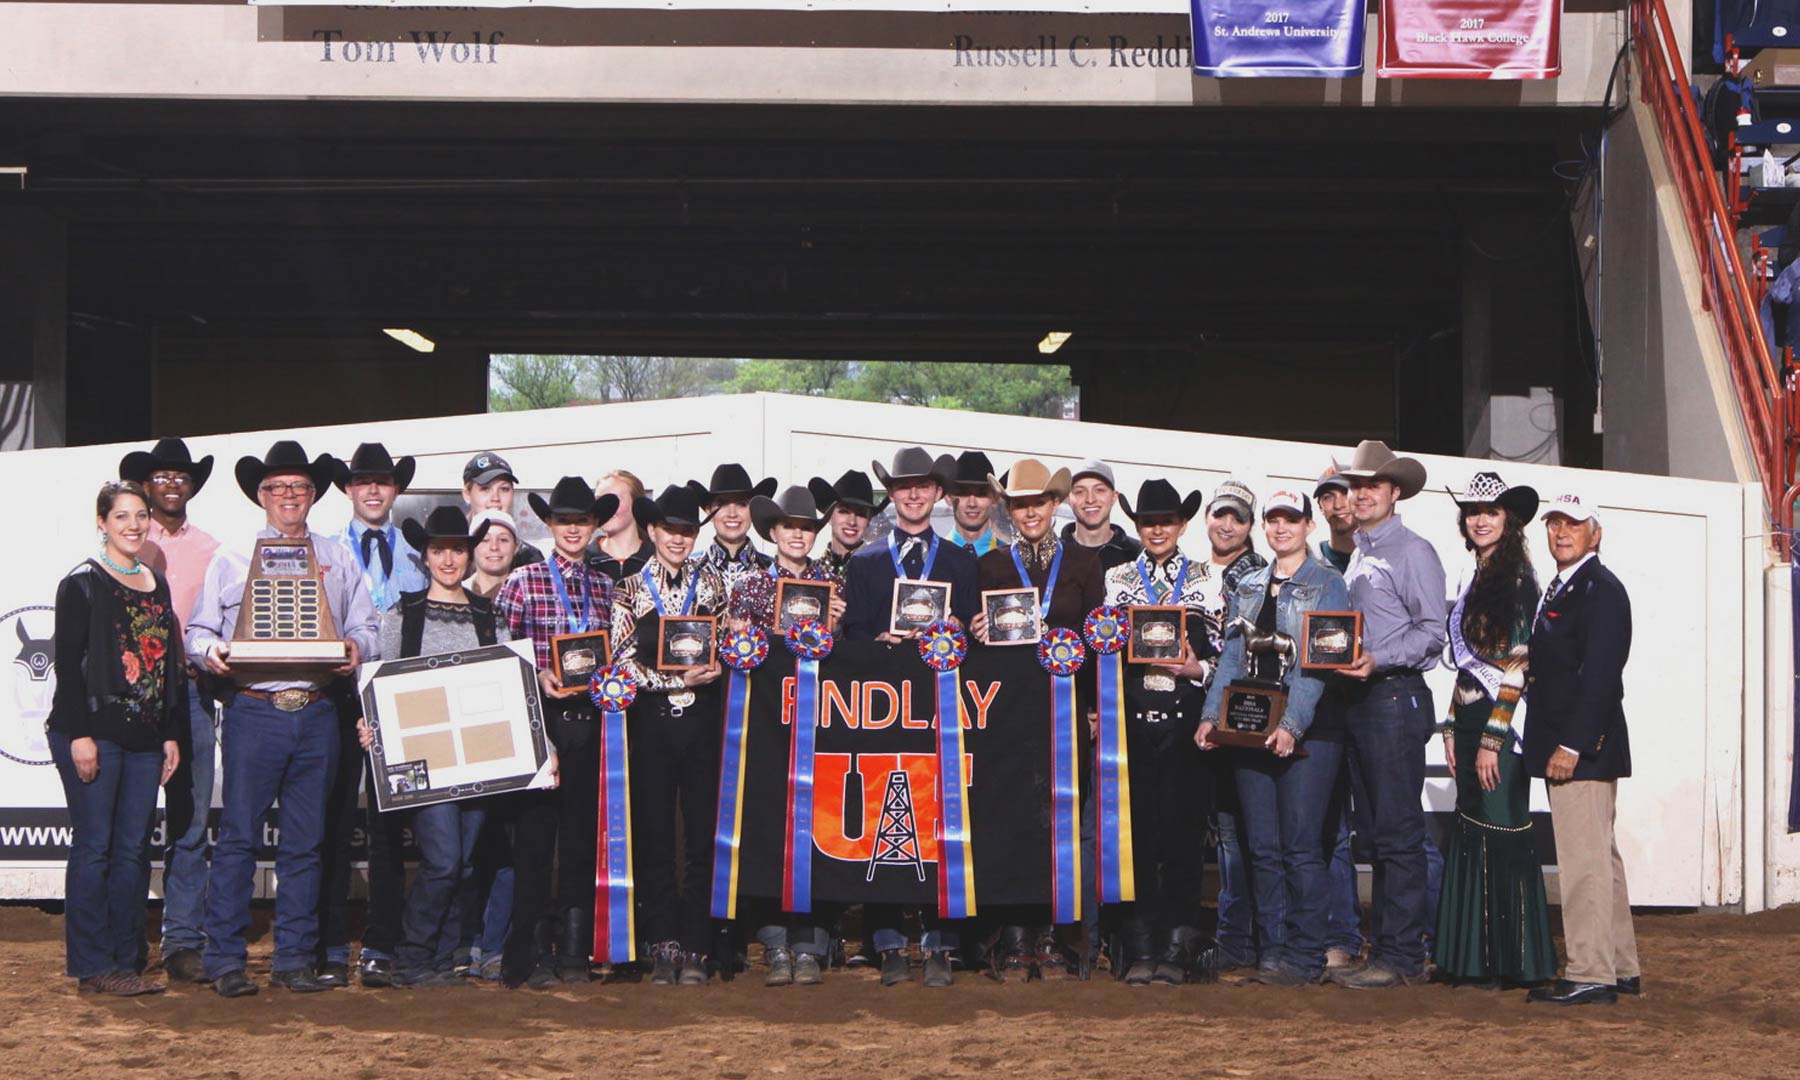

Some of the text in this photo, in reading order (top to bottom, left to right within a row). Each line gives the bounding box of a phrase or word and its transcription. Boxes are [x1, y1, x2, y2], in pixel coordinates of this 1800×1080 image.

[1264, 12, 1290, 24] 2017
[1460, 18, 1485, 29] 2017
[1214, 26, 1341, 41] St. Andrews University
[1416, 32, 1530, 47] Black Hawk College
[312, 30, 505, 63] Tom Wolf
[953, 34, 1193, 68] Russell C. Reddi
[781, 676, 1002, 730] FNDLY
